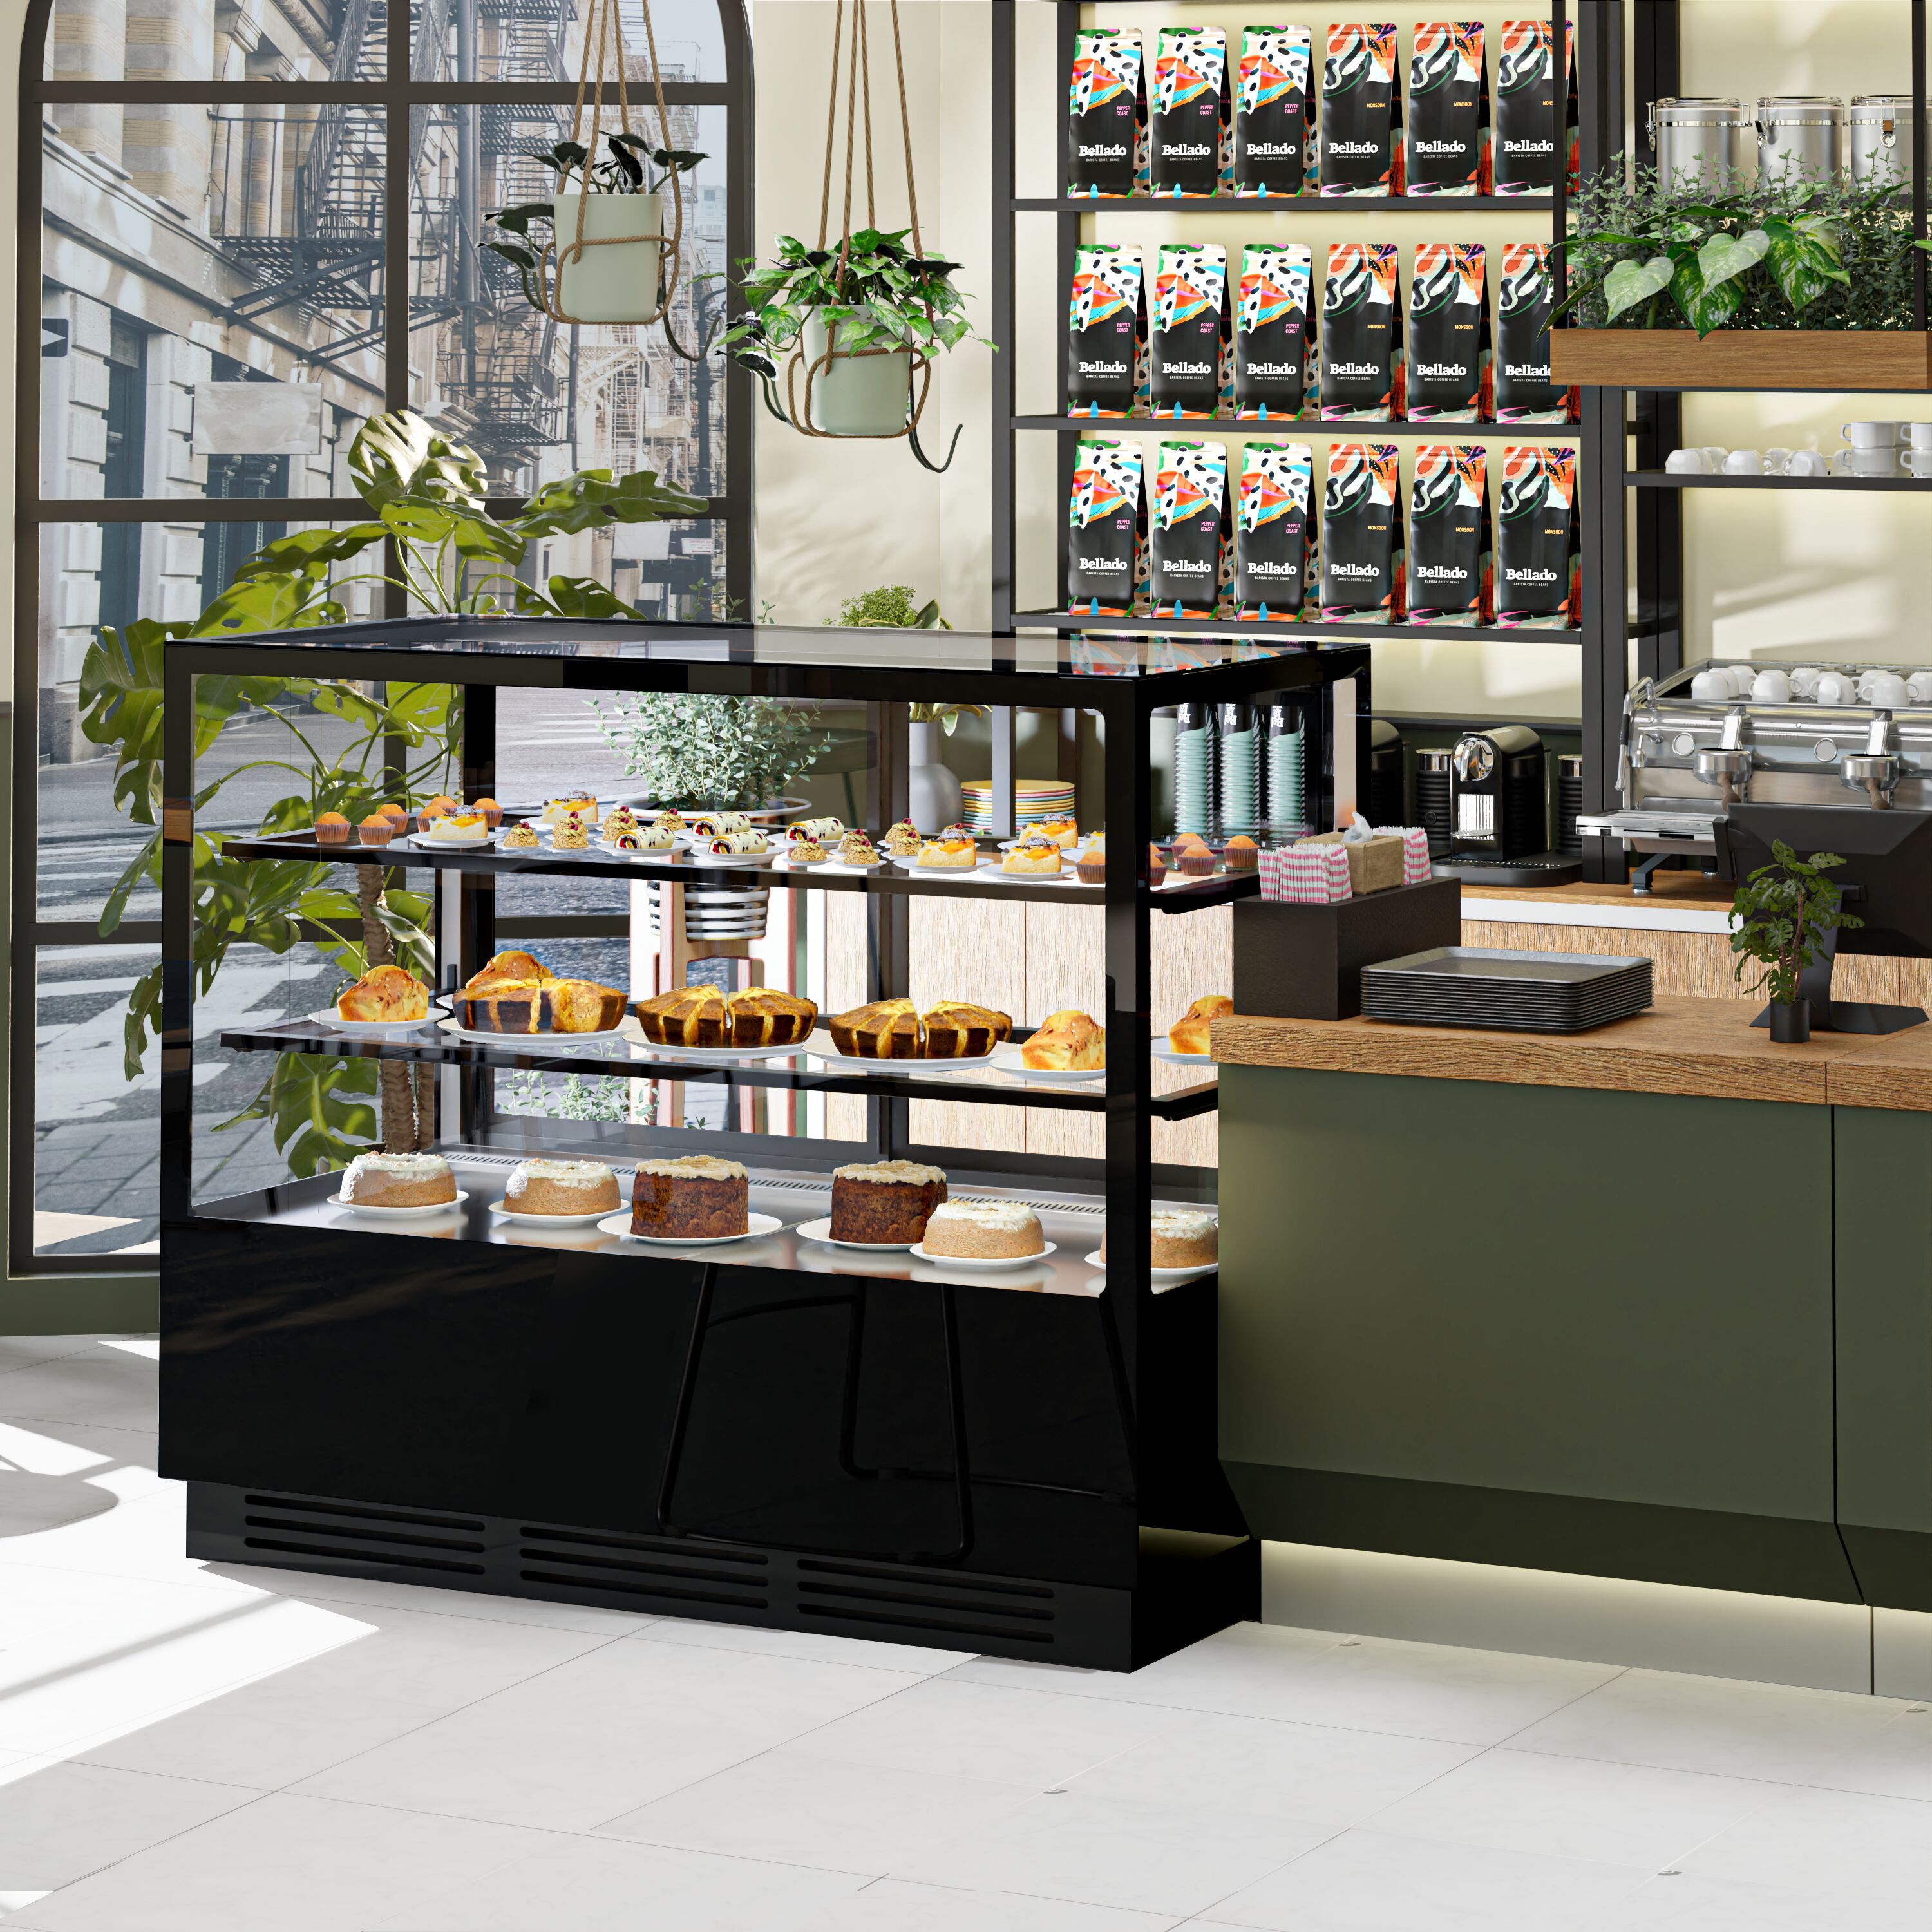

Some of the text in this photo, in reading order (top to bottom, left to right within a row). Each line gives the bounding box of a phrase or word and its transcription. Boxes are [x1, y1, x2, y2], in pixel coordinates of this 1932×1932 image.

[1079, 144, 1126, 156] Bellado
[1162, 144, 1211, 155] Bellado
[1247, 143, 1296, 155] Bellado
[1329, 142, 1378, 153] Bellado
[1416, 140, 1466, 152] Bellado
[1504, 140, 1553, 151] Bellado
[1079, 361, 1127, 373] Bellado
[1162, 362, 1211, 374] Bellado
[1247, 363, 1296, 374] Bellado
[1330, 363, 1379, 374] Bellado
[1417, 364, 1466, 375] Bellado
[1079, 558, 1127, 570] Bellado
[1163, 560, 1211, 573] Bellado
[1247, 562, 1297, 575] Bellado
[1331, 564, 1379, 576] Bellado
[1417, 566, 1467, 579] Bellado
[1506, 569, 1557, 581] Bellado
